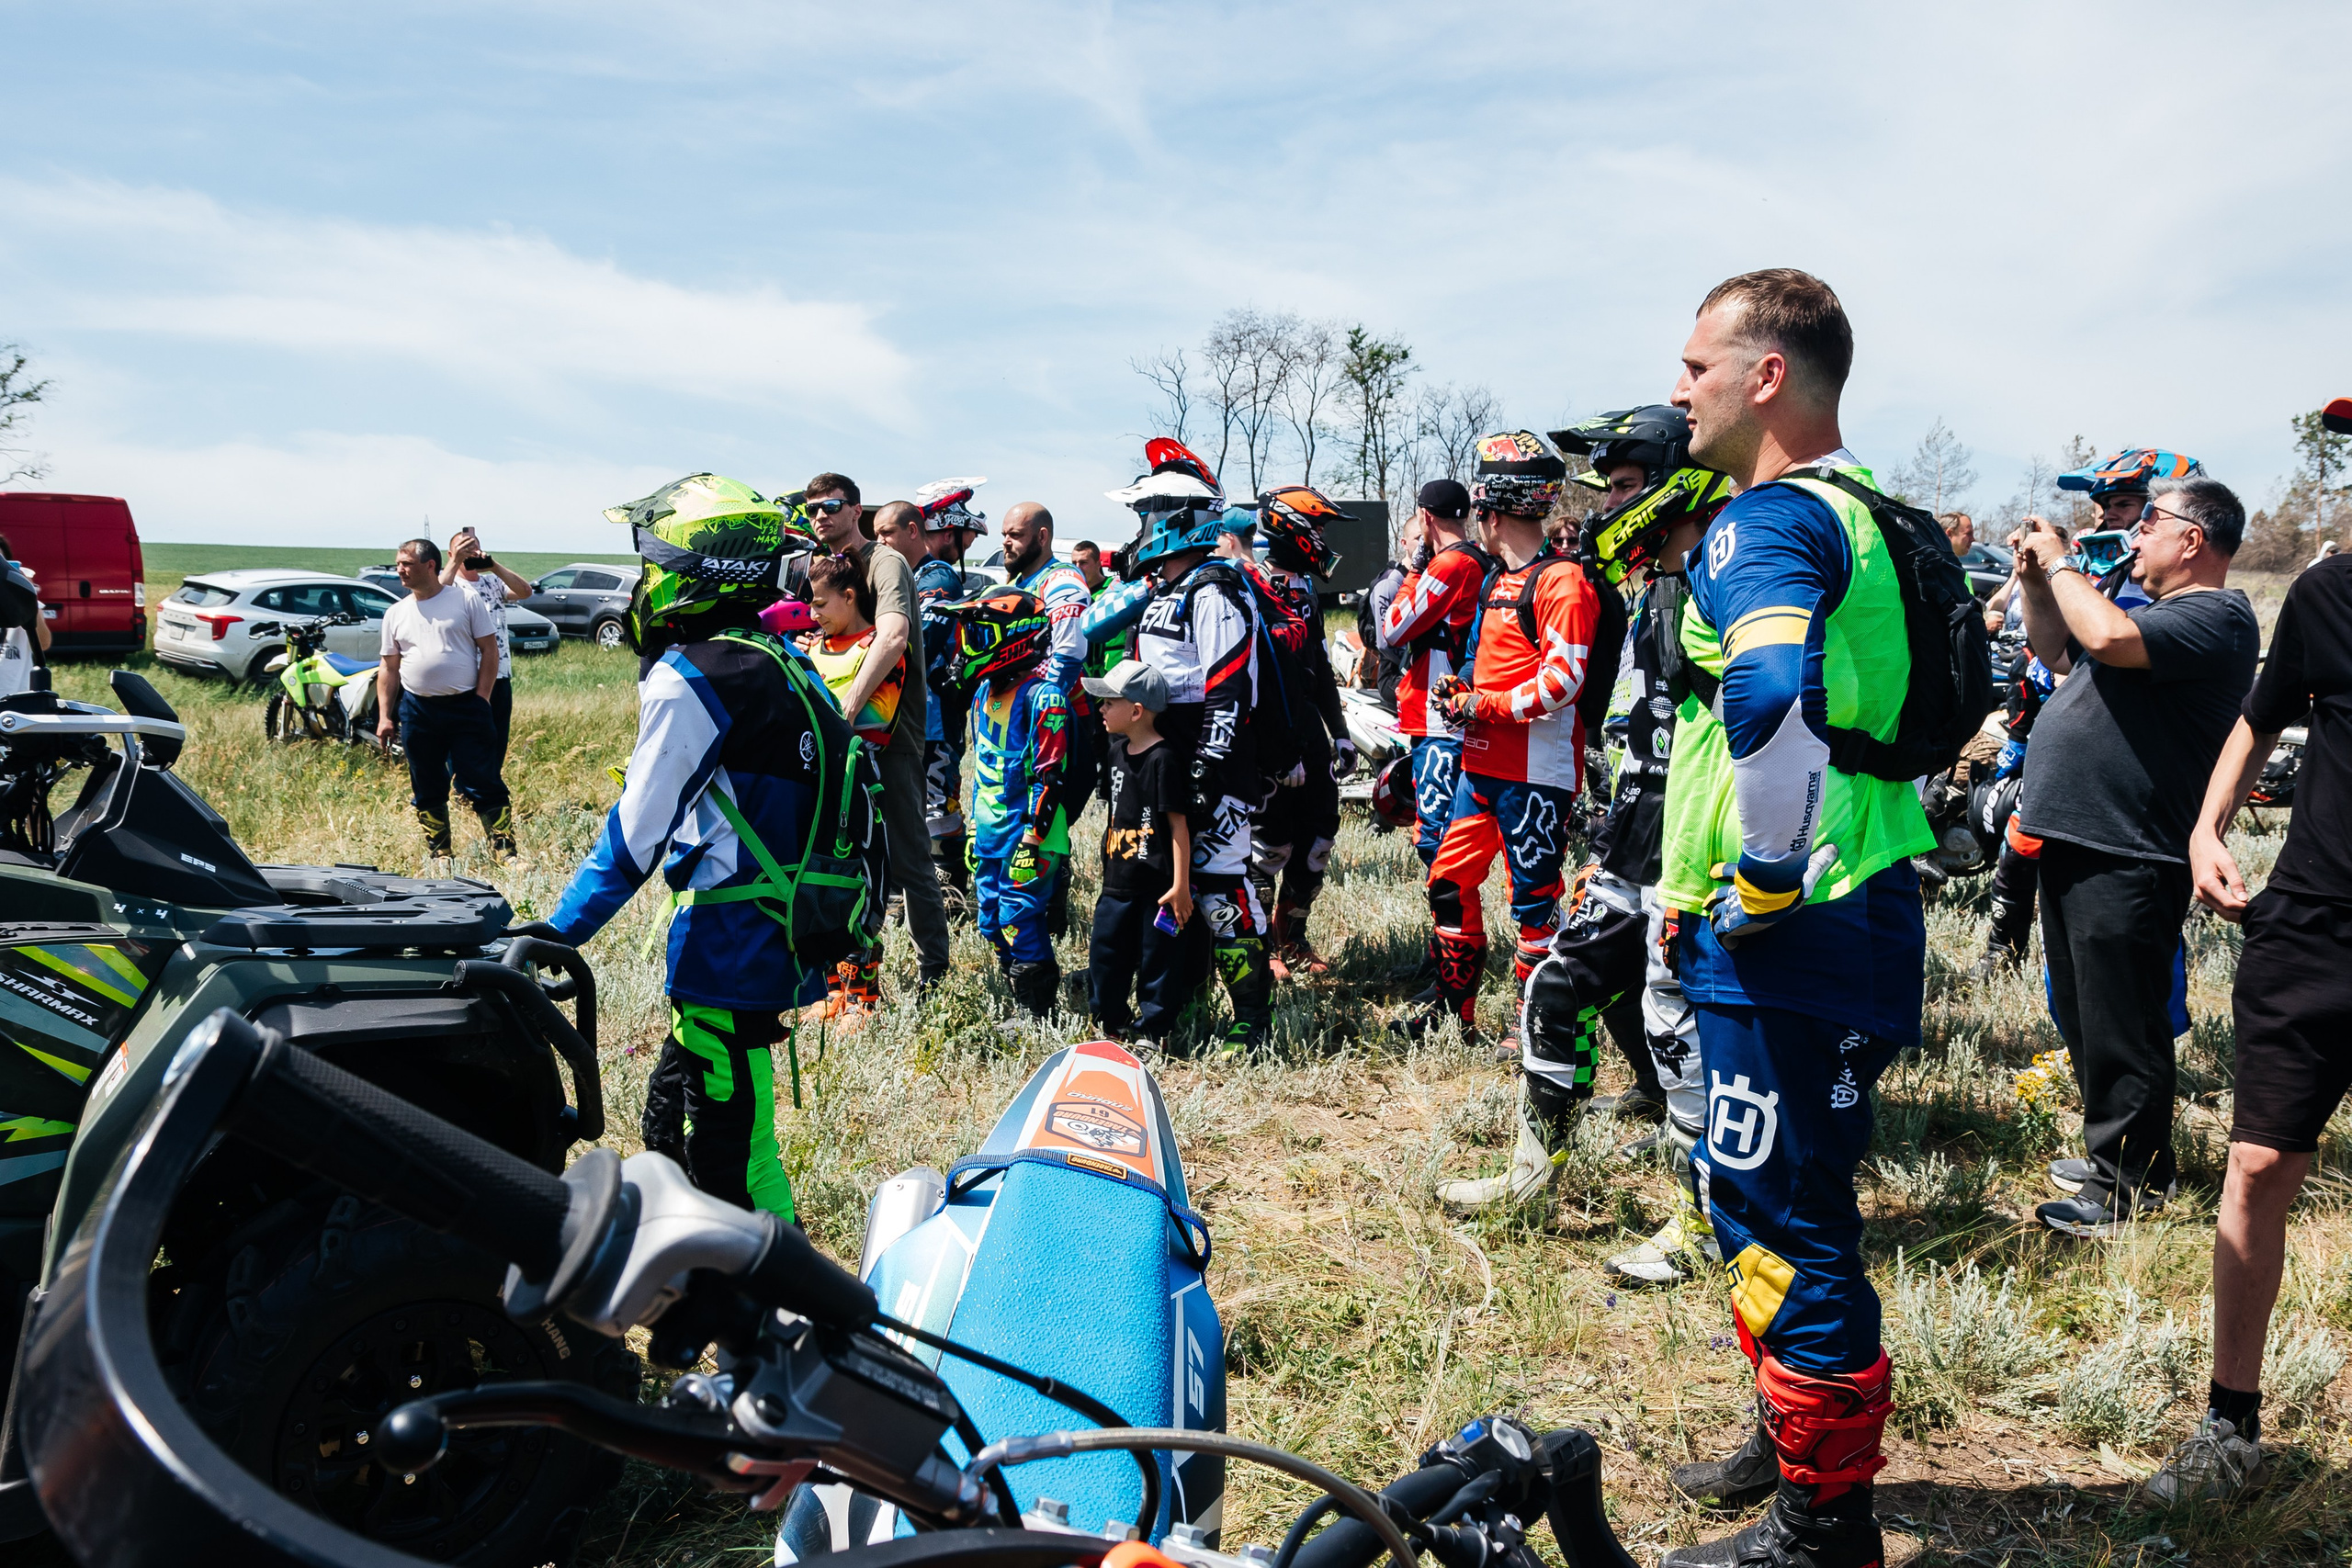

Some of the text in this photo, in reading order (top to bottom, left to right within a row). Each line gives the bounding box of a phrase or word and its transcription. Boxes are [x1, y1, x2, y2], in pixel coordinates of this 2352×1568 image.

[701, 557, 771, 572] ATAKI
[1051, 604, 1080, 623] FXR
[1039, 694, 1067, 710] FOX
[1797, 770, 1817, 838] Husqvarna
[180, 852, 217, 874] EPS
[0, 972, 99, 1026] SHARMAX
[1052, 1110, 1129, 1134] TAGENDURO
[1090, 1107, 1110, 1118] 61
